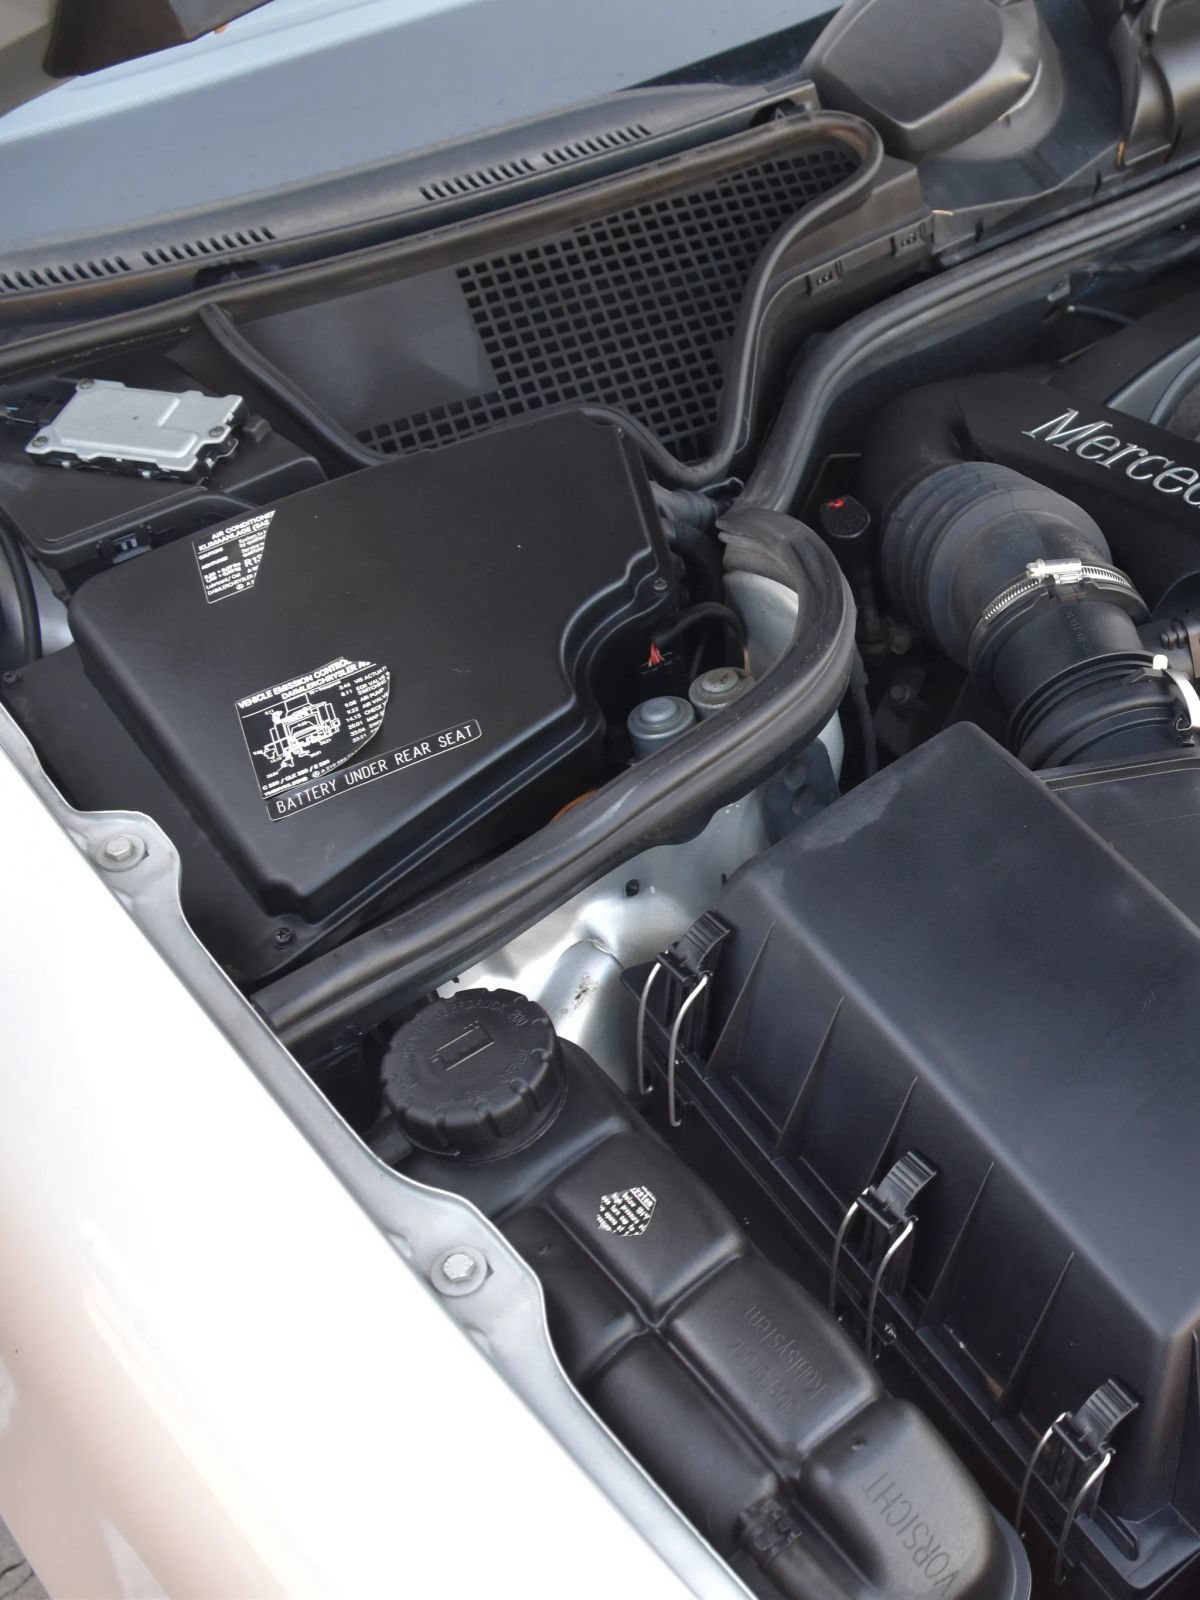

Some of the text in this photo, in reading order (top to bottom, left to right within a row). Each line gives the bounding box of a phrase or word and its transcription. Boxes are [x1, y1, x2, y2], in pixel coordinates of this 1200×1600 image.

[225, 509, 276, 534] CONDITIONE
[238, 690, 273, 709] VEHICLE
[273, 675, 315, 696] EMISSION
[281, 662, 358, 700] DAIMLERCHRYSLER
[276, 779, 337, 814] BATTERY
[345, 760, 388, 786] UNDER
[395, 742, 432, 767] REAR
[438, 725, 474, 749] SEAT
[863, 1472, 960, 1597] VORSICHT
